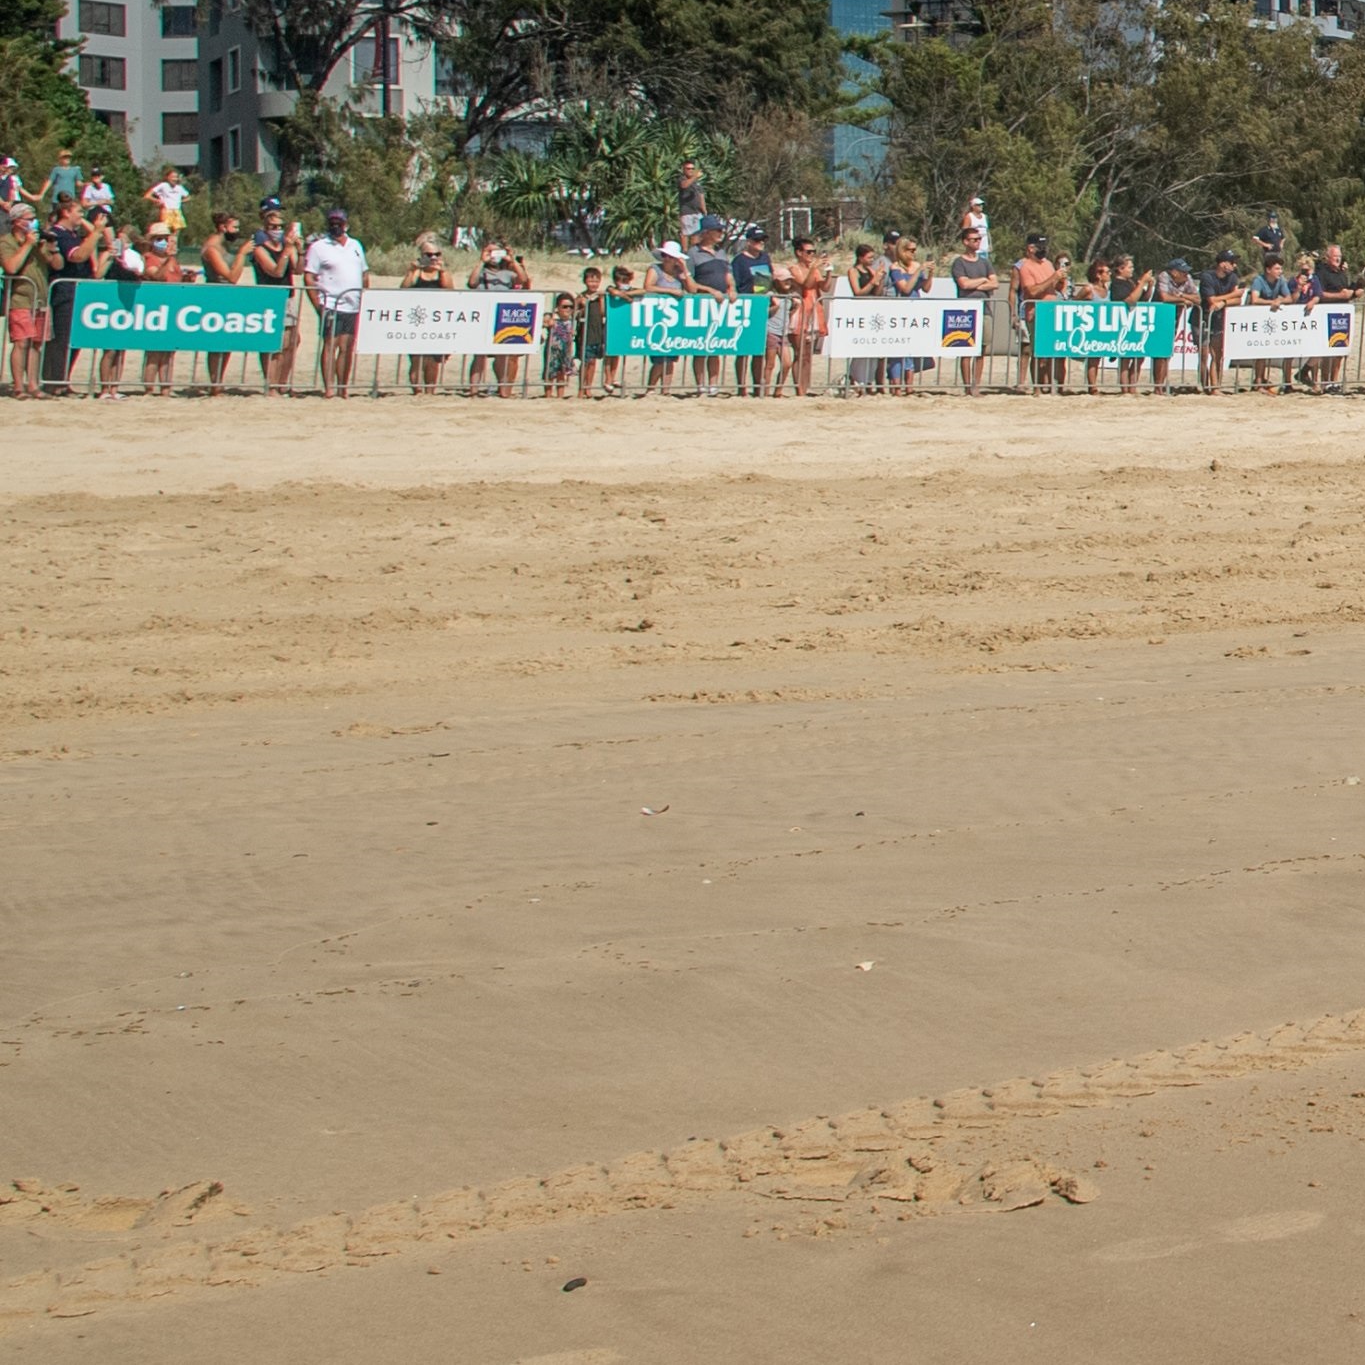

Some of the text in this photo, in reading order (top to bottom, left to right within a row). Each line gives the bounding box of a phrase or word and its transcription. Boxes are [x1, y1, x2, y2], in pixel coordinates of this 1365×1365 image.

[81, 301, 277, 334] Gold Coast
[366, 309, 481, 323] THE STAR
[631, 297, 752, 328] IT'S LIVE!
[1054, 305, 1156, 332] IT'S LIVE!
[835, 317, 930, 328] THE STAR
[1230, 321, 1318, 332] THE STAR
[387, 332, 457, 340] GOLD COAST
[631, 320, 744, 353] in Queensland
[852, 337, 878, 345] GOLD
[1054, 326, 1149, 355] in Queensland
[1247, 339, 1270, 347] GOLD
